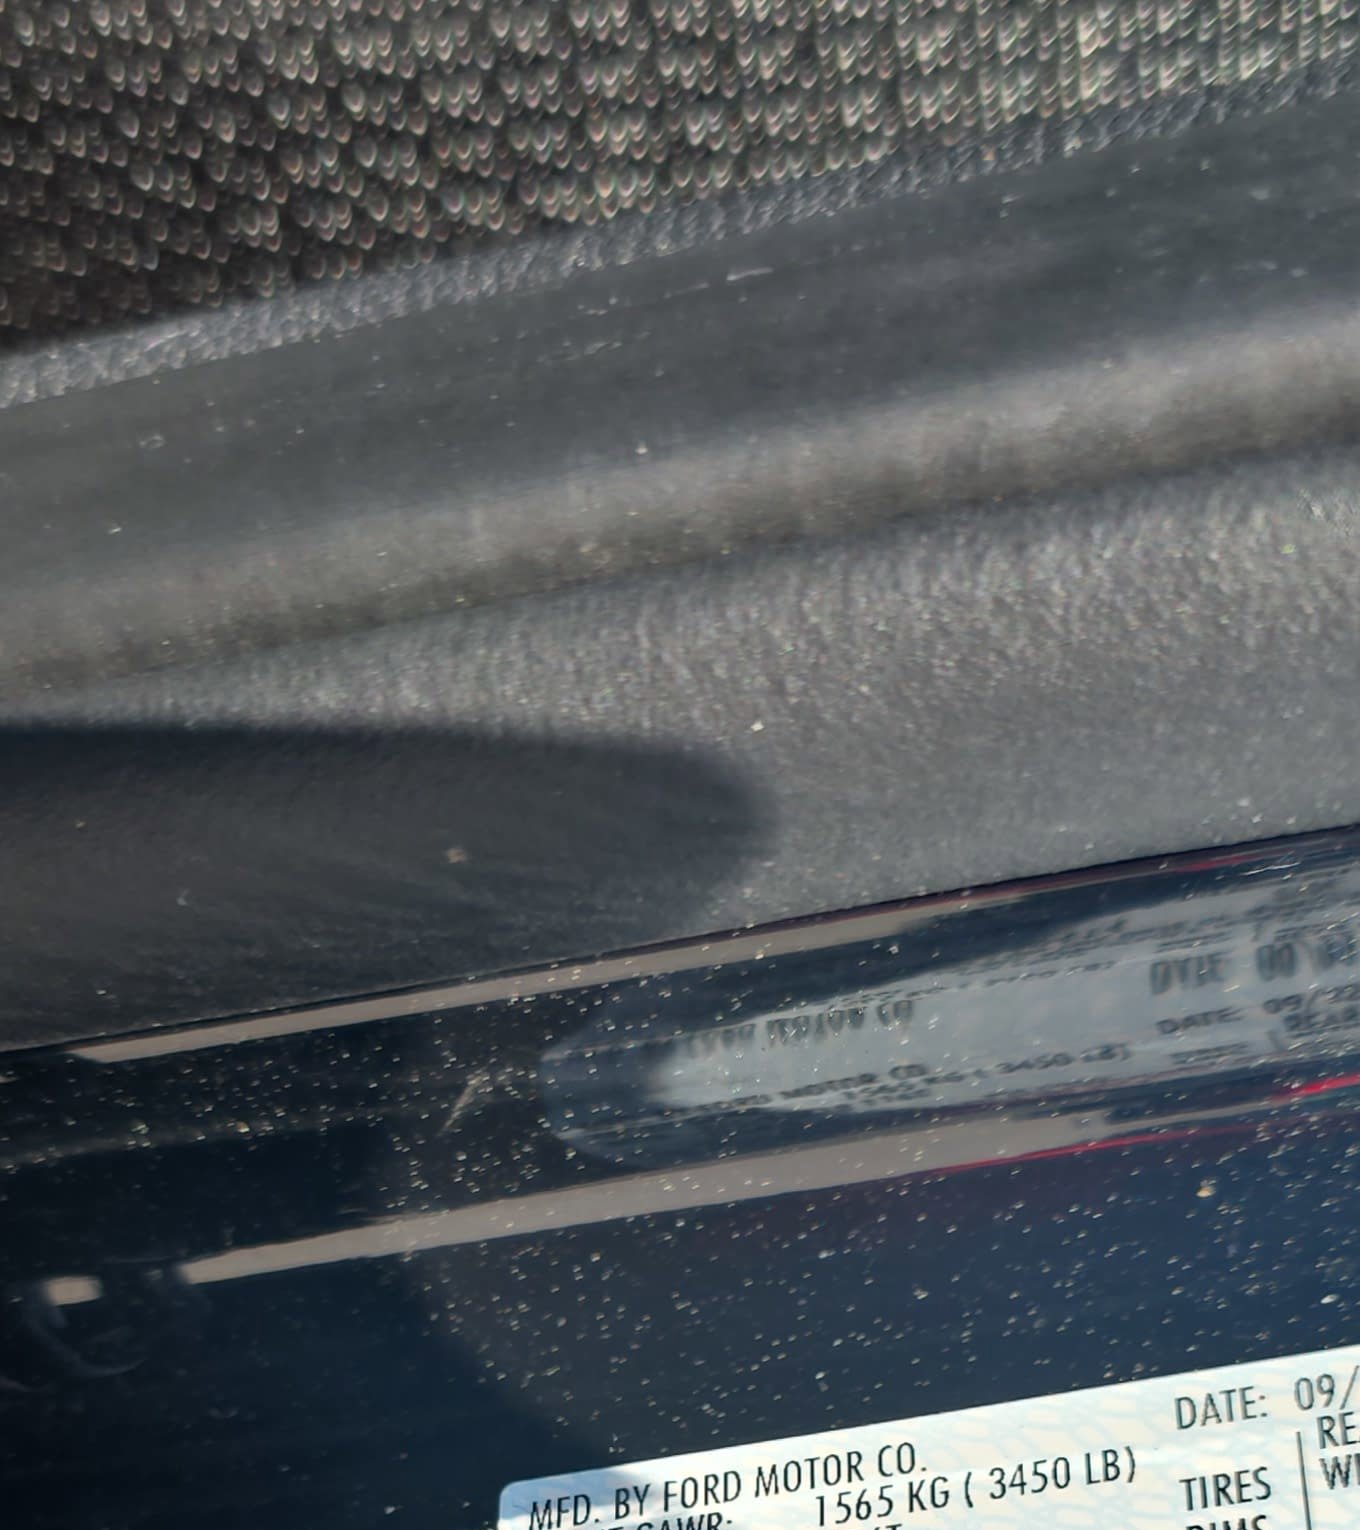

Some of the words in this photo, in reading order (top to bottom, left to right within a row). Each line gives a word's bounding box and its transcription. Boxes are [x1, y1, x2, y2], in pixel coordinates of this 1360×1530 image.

[1175, 1386, 1268, 1430] DATE:
[615, 1484, 651, 1520] BY
[663, 1471, 741, 1512] FORD
[754, 1451, 864, 1498] MOTOR
[877, 1442, 927, 1477] CO.
[816, 1484, 894, 1527] 1565
[908, 1477, 949, 1512] KG
[990, 1457, 1071, 1499] 3450
[1085, 1446, 1136, 1485] LB)
[1180, 1467, 1272, 1511] TIRES
